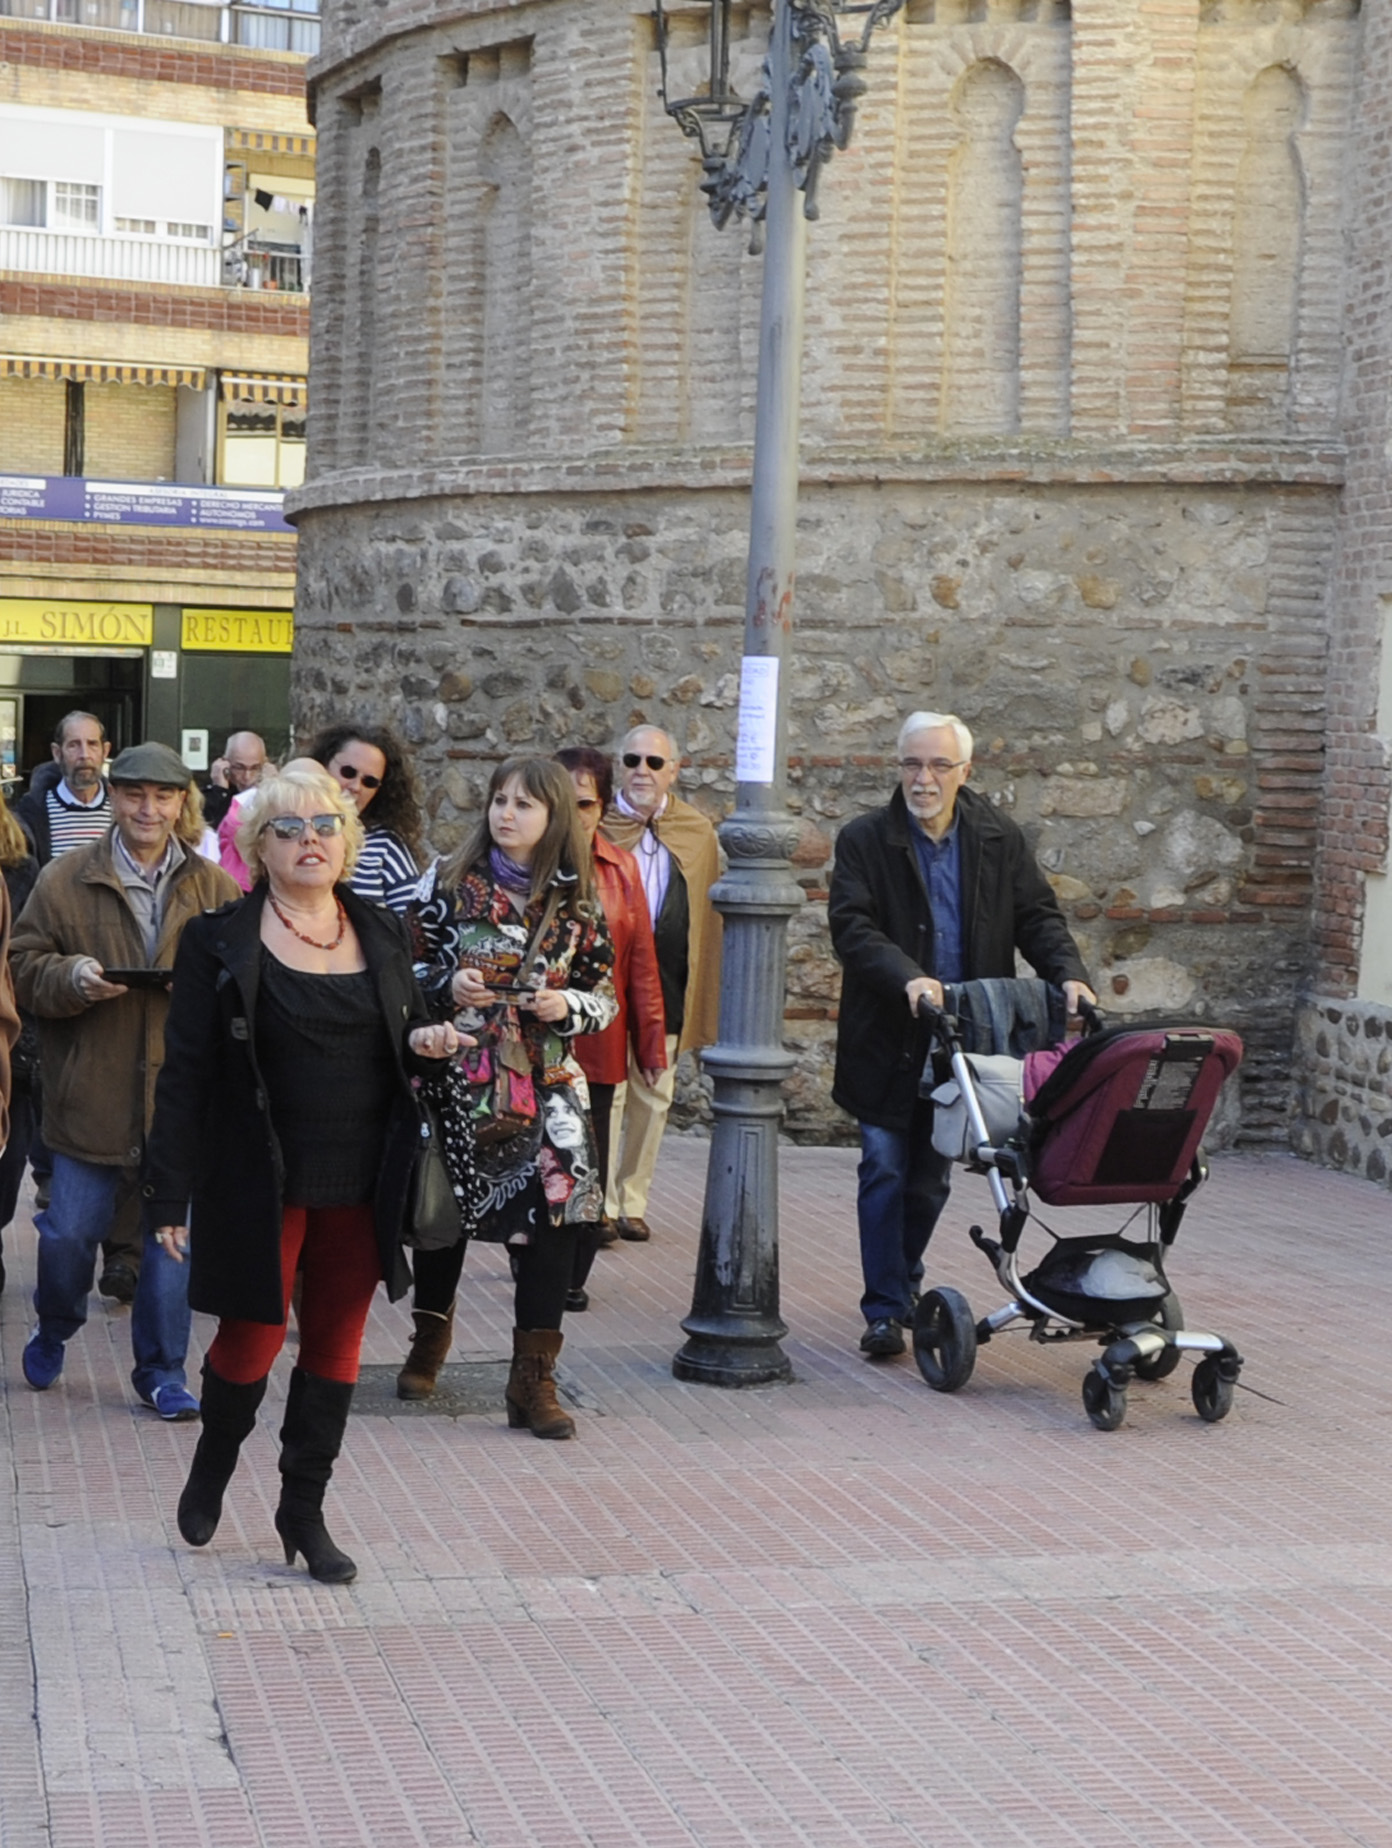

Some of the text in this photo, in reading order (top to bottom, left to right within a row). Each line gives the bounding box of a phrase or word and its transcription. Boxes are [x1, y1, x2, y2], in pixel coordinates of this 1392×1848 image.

[1, 489, 40, 498] JURIDICA
[0, 497, 45, 508] CONTABLE
[93, 494, 183, 507] GRANDES EMPRESAS
[200, 500, 240, 509] DERECHO
[133, 505, 177, 514] TRIBUTARIA
[40, 606, 149, 642] SIMÓN
